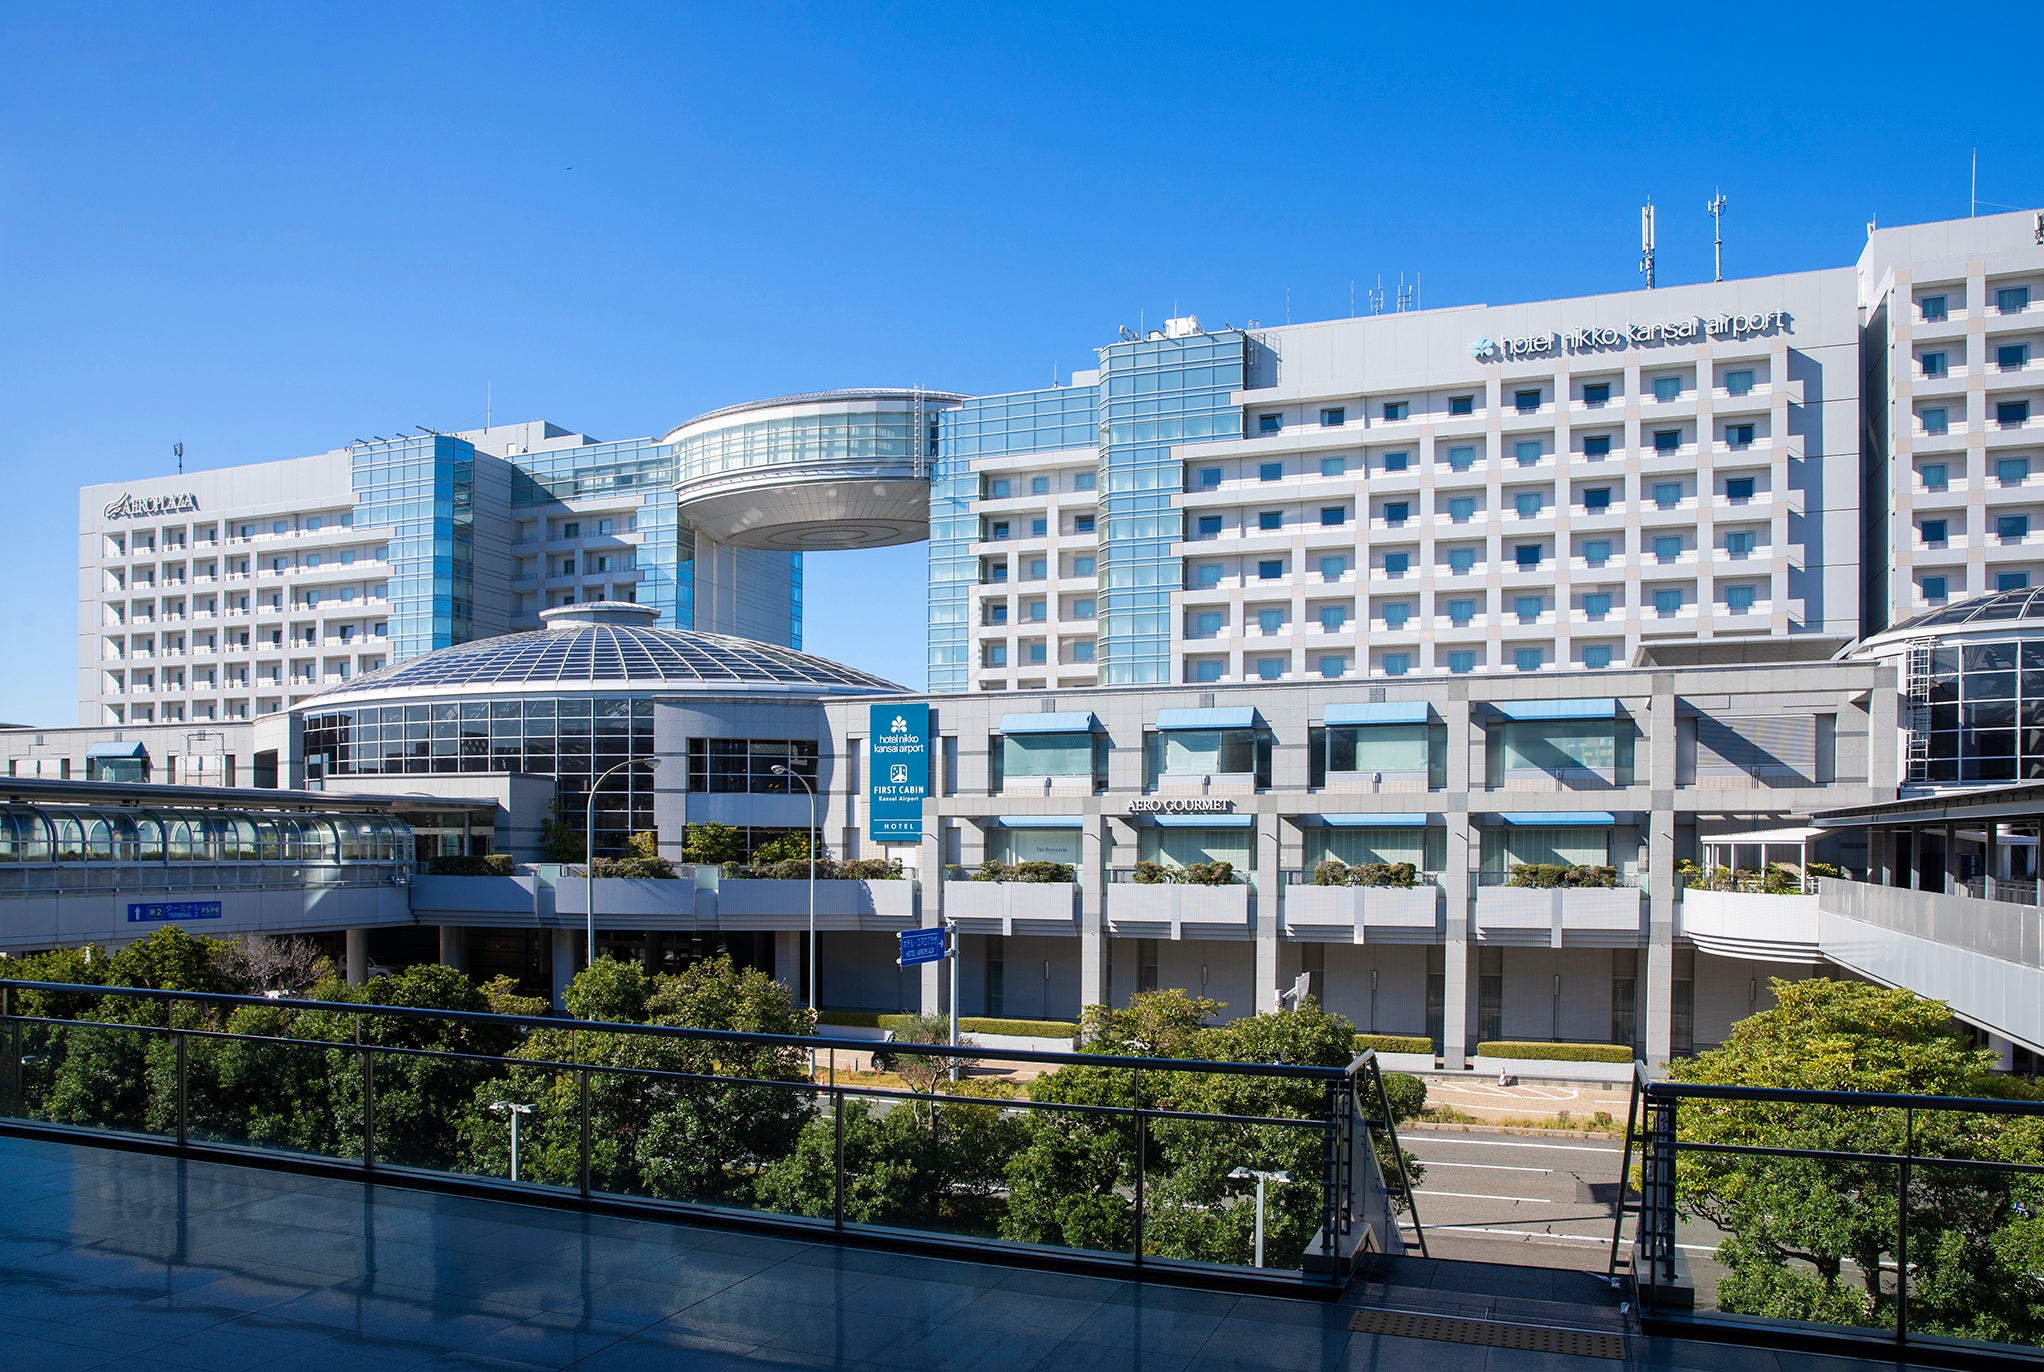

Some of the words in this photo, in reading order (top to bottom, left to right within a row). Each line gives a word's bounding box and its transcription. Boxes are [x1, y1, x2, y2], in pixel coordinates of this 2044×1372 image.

[1500, 329, 1553, 354] hotel
[1626, 314, 1698, 342] kansai
[1705, 308, 1785, 337] airport
[121, 493, 194, 513] AEROPLAZA
[879, 734, 898, 743] hotel
[899, 734, 919, 743] nikko
[874, 743, 898, 753] kansai
[899, 743, 924, 754] airport
[874, 786, 896, 794] FIRST
[899, 786, 924, 794] CABIN
[1128, 799, 1161, 811] AERO
[1164, 799, 1230, 811] GOURMET
[165, 904, 200, 913] ターミナル
